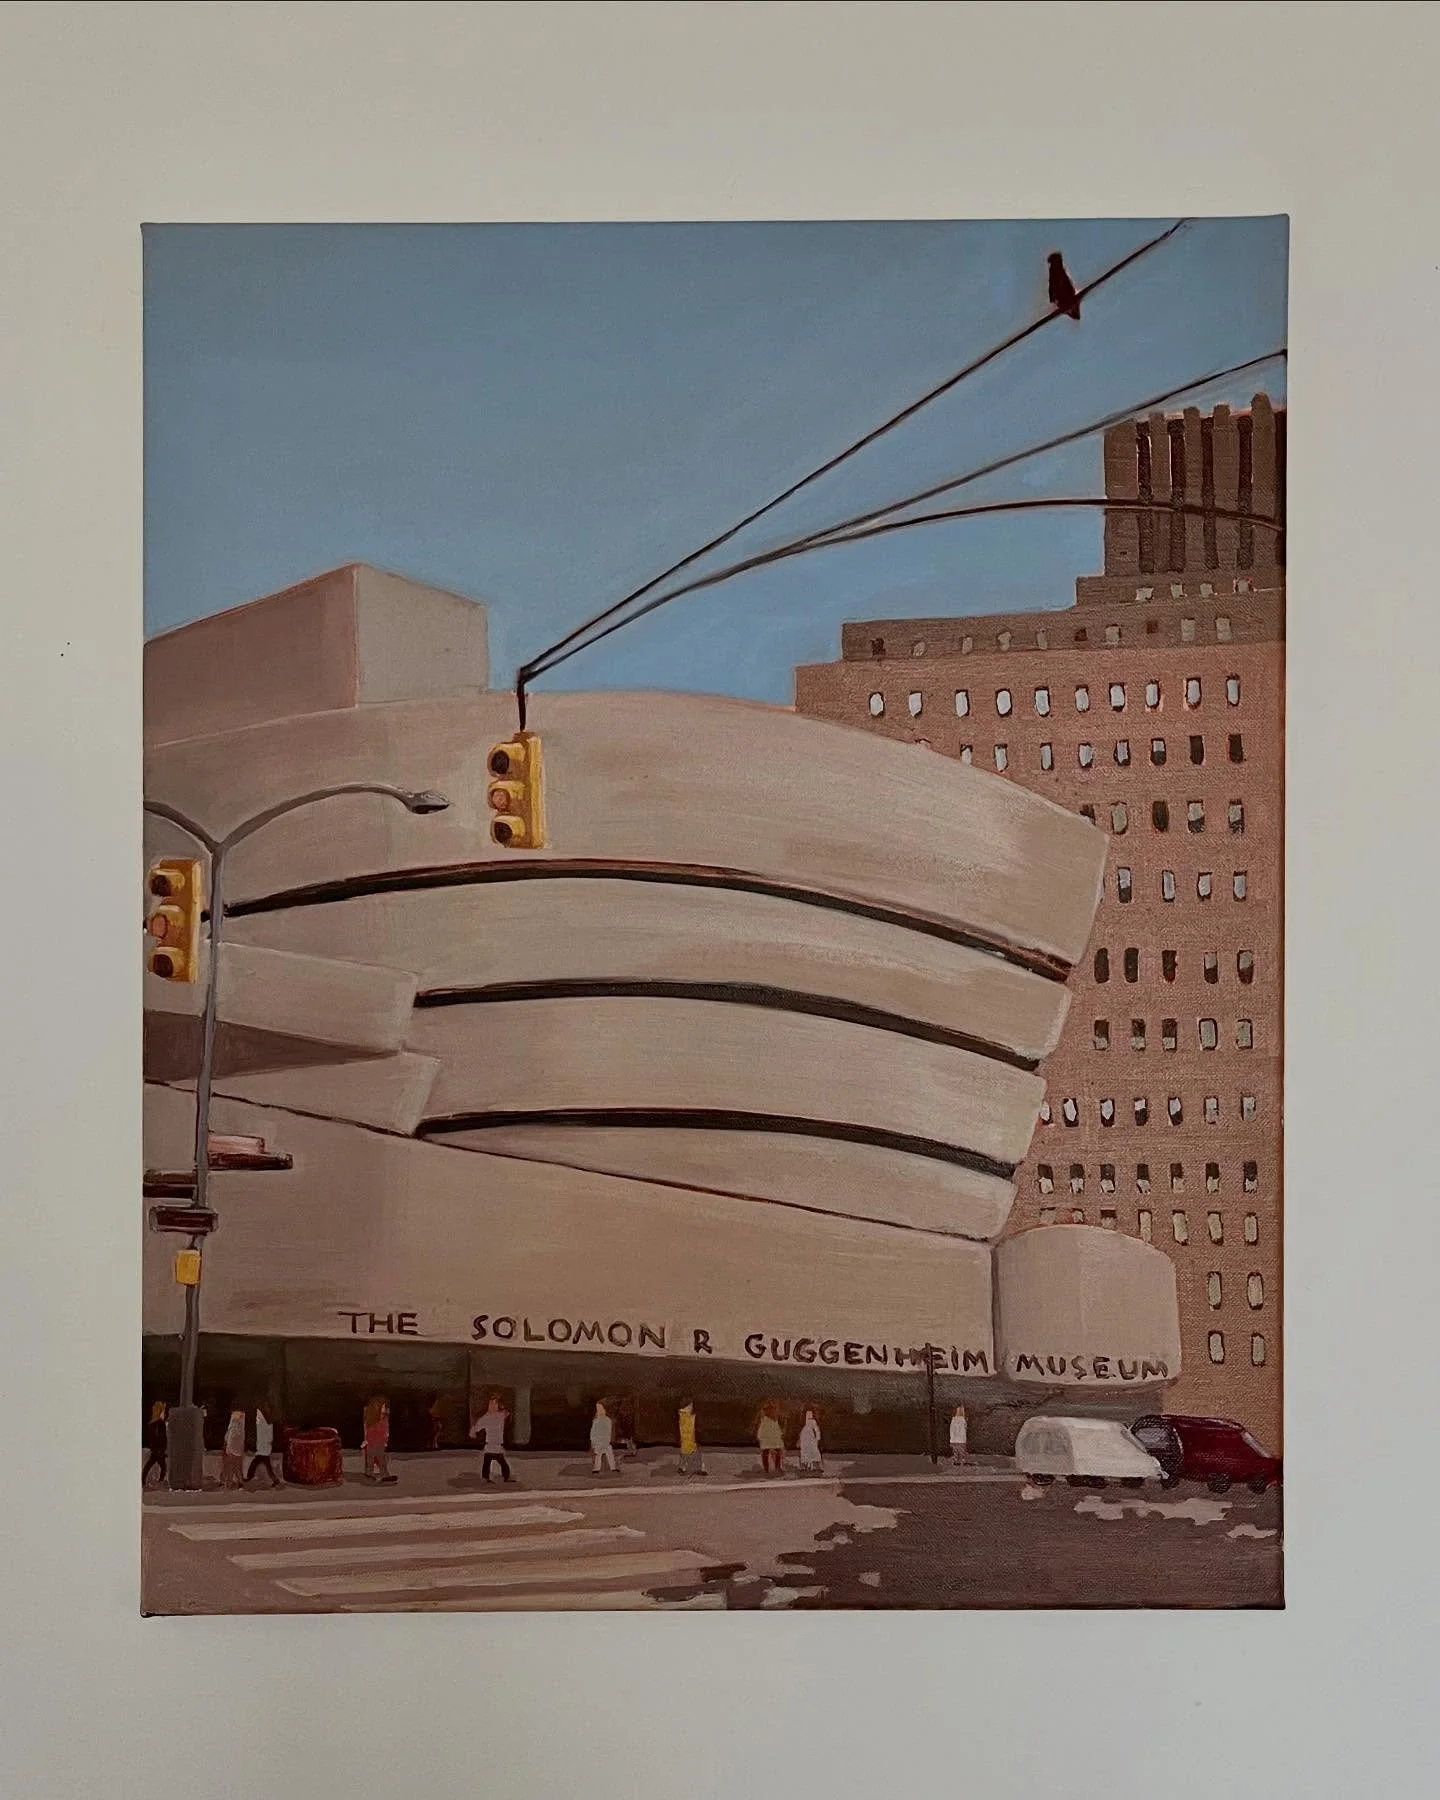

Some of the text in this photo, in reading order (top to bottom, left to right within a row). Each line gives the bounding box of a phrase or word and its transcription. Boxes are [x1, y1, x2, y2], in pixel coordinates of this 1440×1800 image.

[337, 1311, 1170, 1381] THE SOLOMON R GUGGENHEIM MUSEUM
